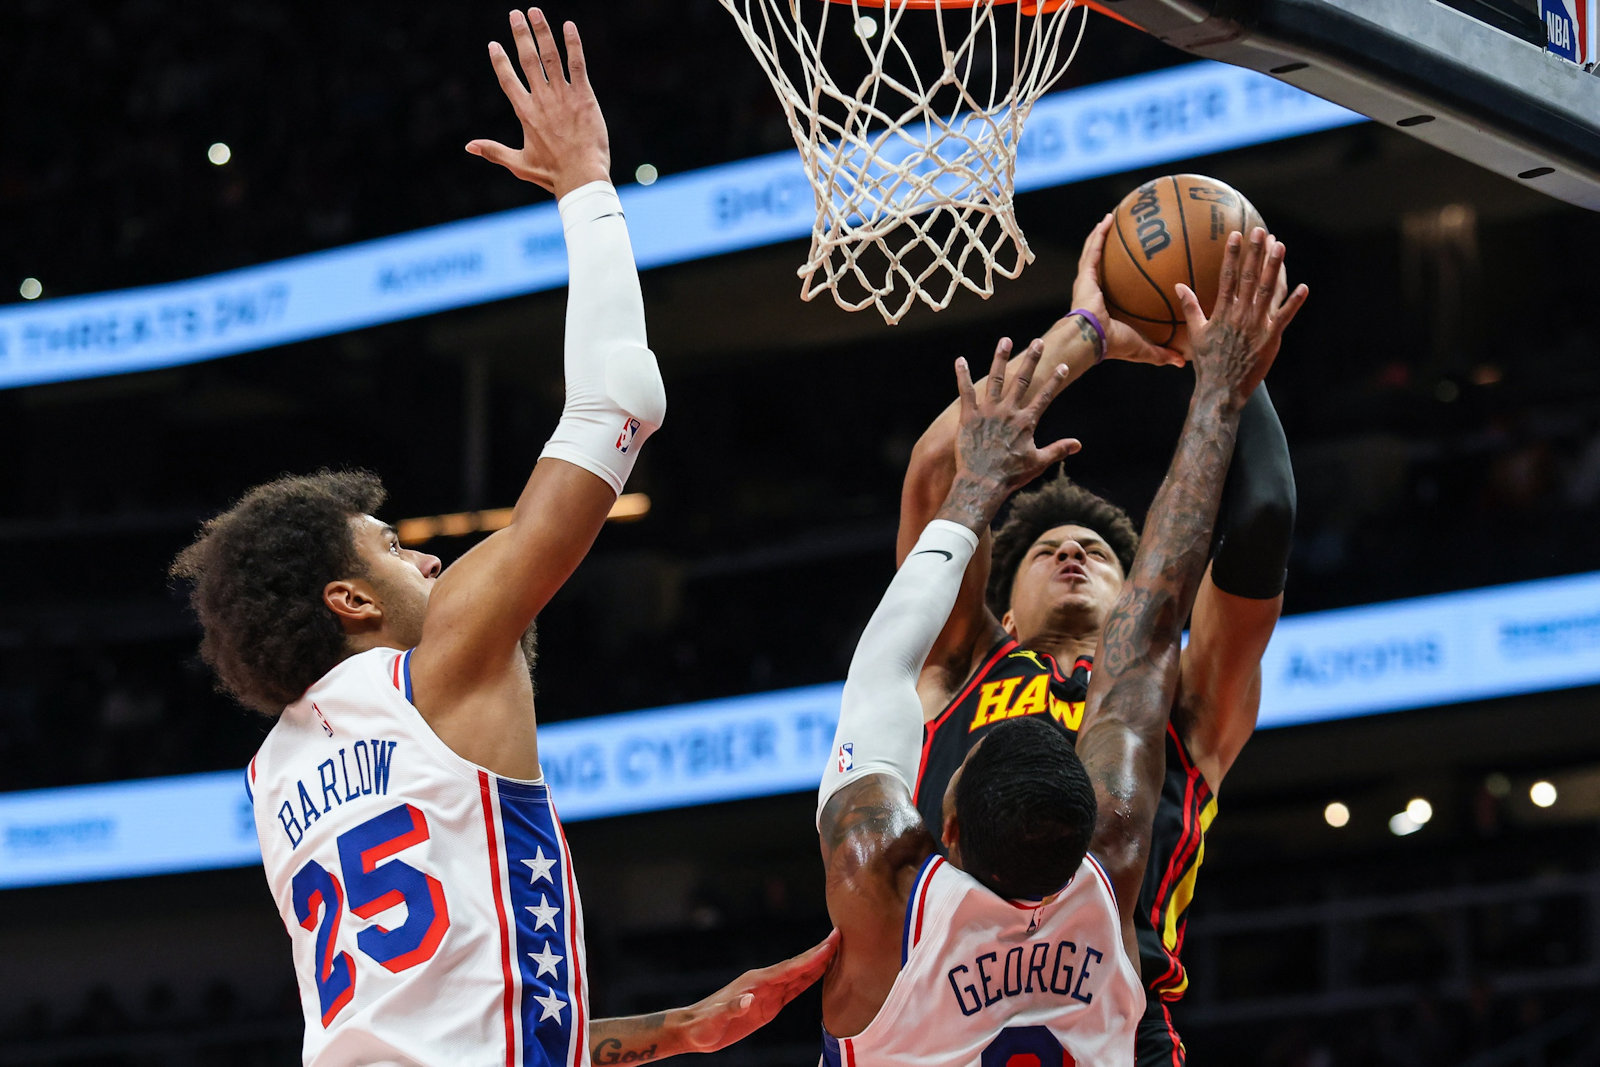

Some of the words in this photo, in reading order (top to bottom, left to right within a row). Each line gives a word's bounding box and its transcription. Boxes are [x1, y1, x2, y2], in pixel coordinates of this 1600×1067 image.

[1546, 10, 1571, 51] NBA
[1076, 86, 1230, 152] CYBER
[21, 304, 199, 354] THREATS
[968, 673, 1086, 734] HAW
[618, 726, 777, 789] CYBER
[278, 739, 397, 850] BARLOW
[292, 803, 450, 1029] 25
[948, 940, 1103, 1017] GEORGE
[592, 1038, 658, 1066] God
